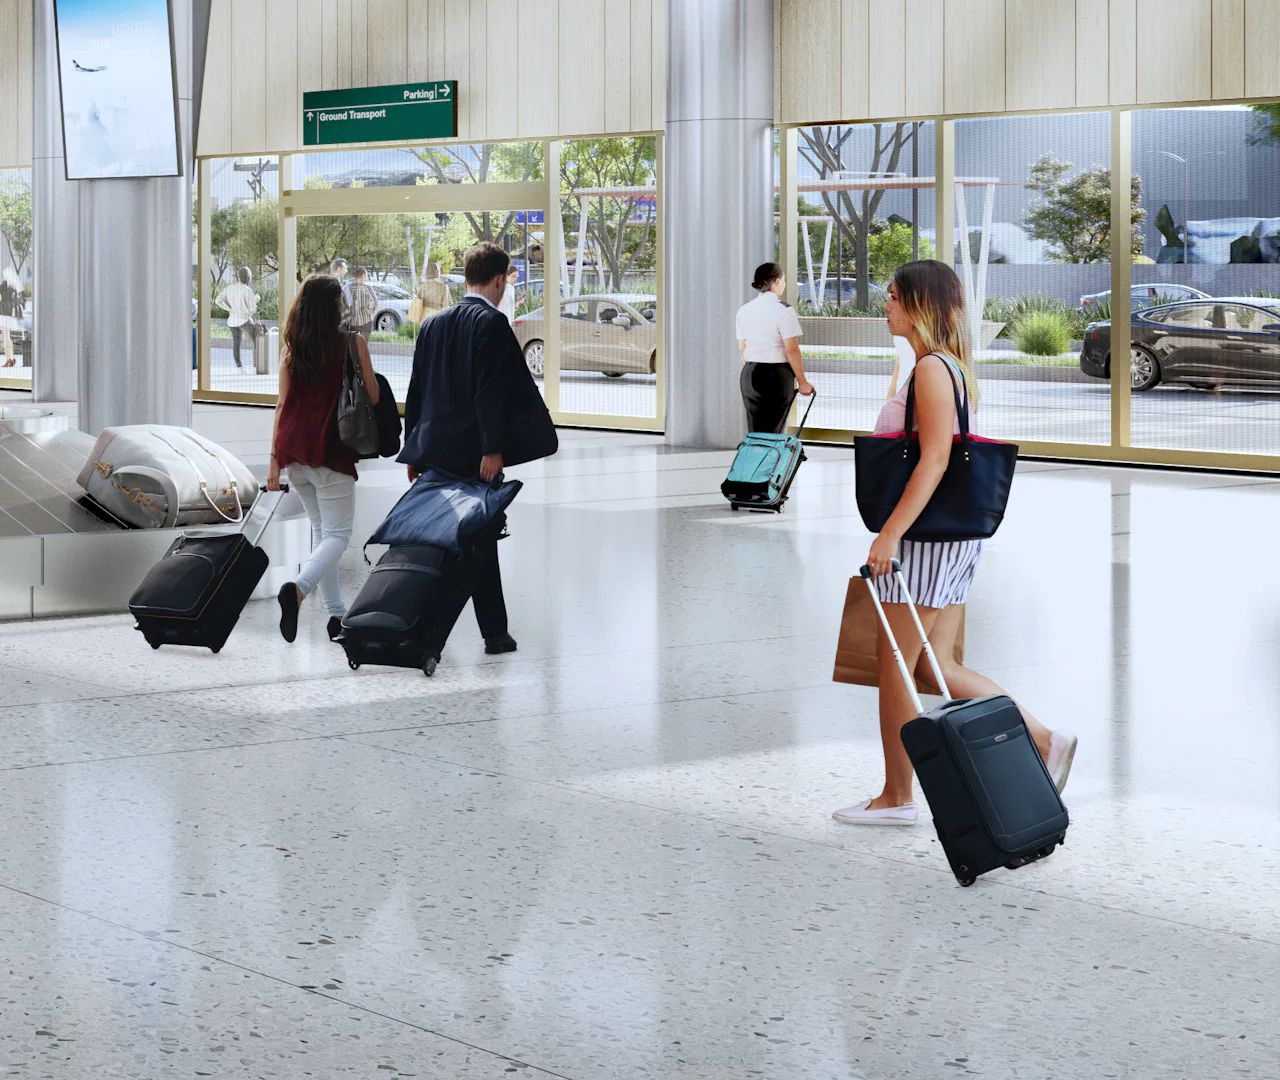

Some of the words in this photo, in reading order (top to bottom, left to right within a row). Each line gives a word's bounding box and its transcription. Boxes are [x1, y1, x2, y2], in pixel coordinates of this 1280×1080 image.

[403, 89, 435, 100] Parking
[320, 111, 348, 121] Ground
[349, 109, 386, 120] Transport
